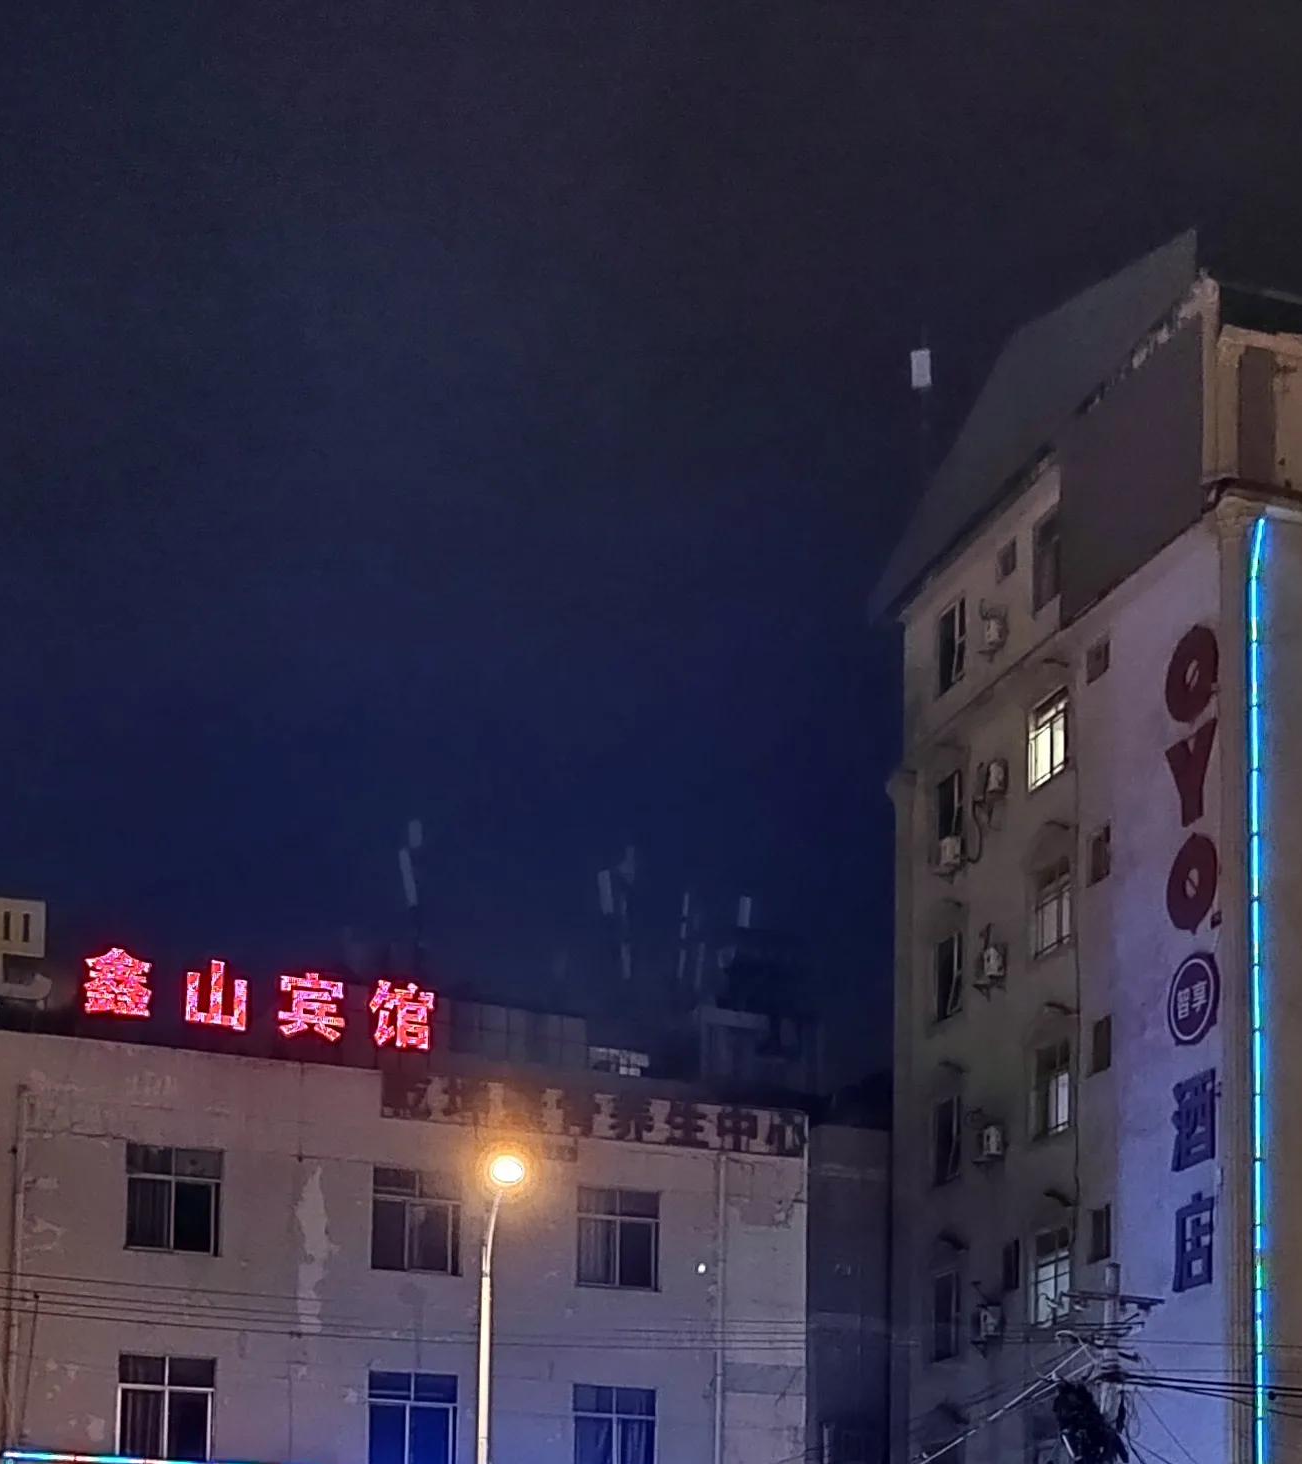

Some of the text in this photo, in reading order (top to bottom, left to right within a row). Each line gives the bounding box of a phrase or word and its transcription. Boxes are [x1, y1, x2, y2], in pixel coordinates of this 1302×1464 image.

[1165, 622, 1219, 935] OYO
[84, 947, 436, 1052] 鑫山宾馆
